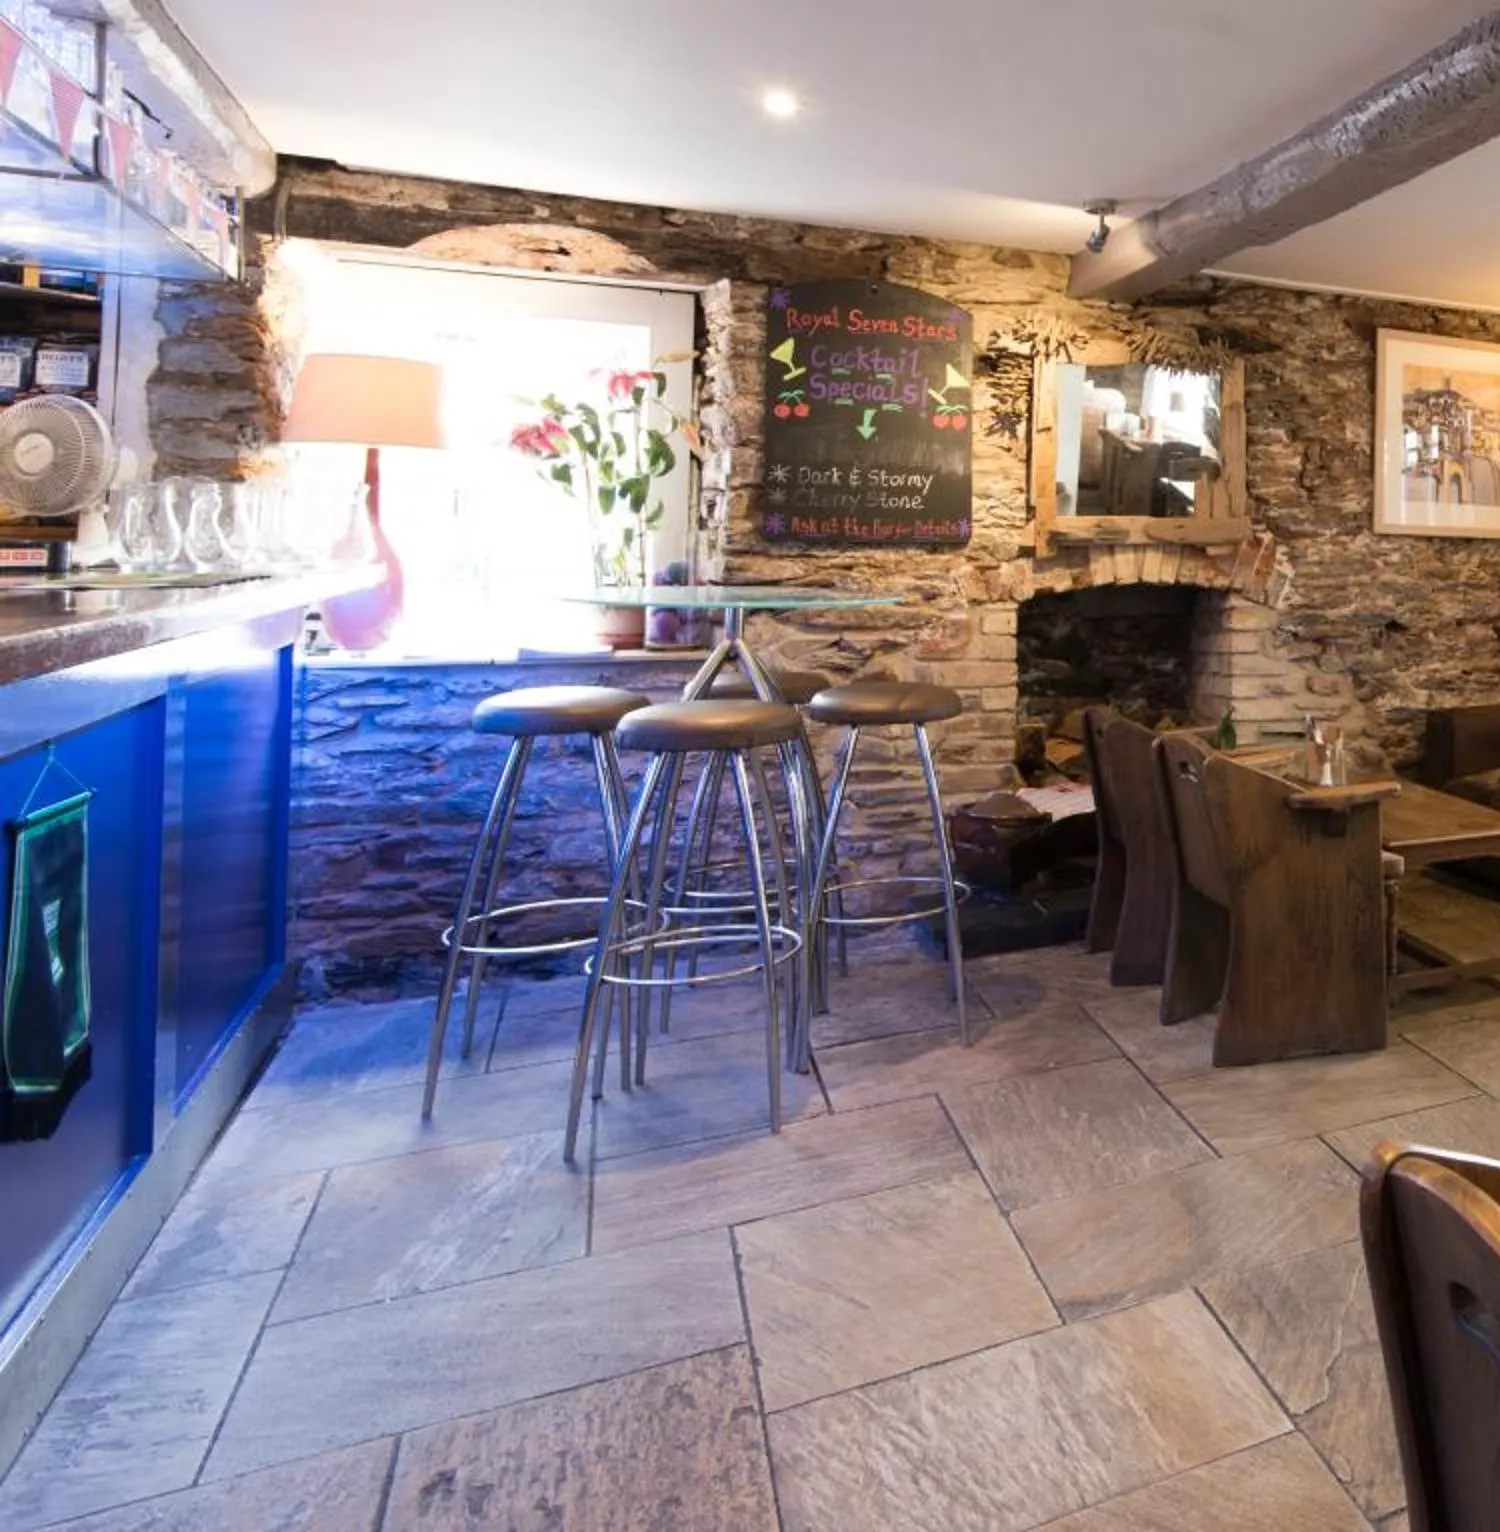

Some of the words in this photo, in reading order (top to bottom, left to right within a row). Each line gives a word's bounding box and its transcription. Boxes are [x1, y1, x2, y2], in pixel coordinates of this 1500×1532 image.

[787, 305, 840, 337] Royal
[847, 308, 899, 334] Seven
[903, 313, 958, 341] Stars
[811, 346, 921, 378] Cocktail
[799, 466, 842, 486] Dark
[867, 468, 934, 496] Stormy
[862, 490, 925, 510] Stone
[844, 515, 869, 536] the
